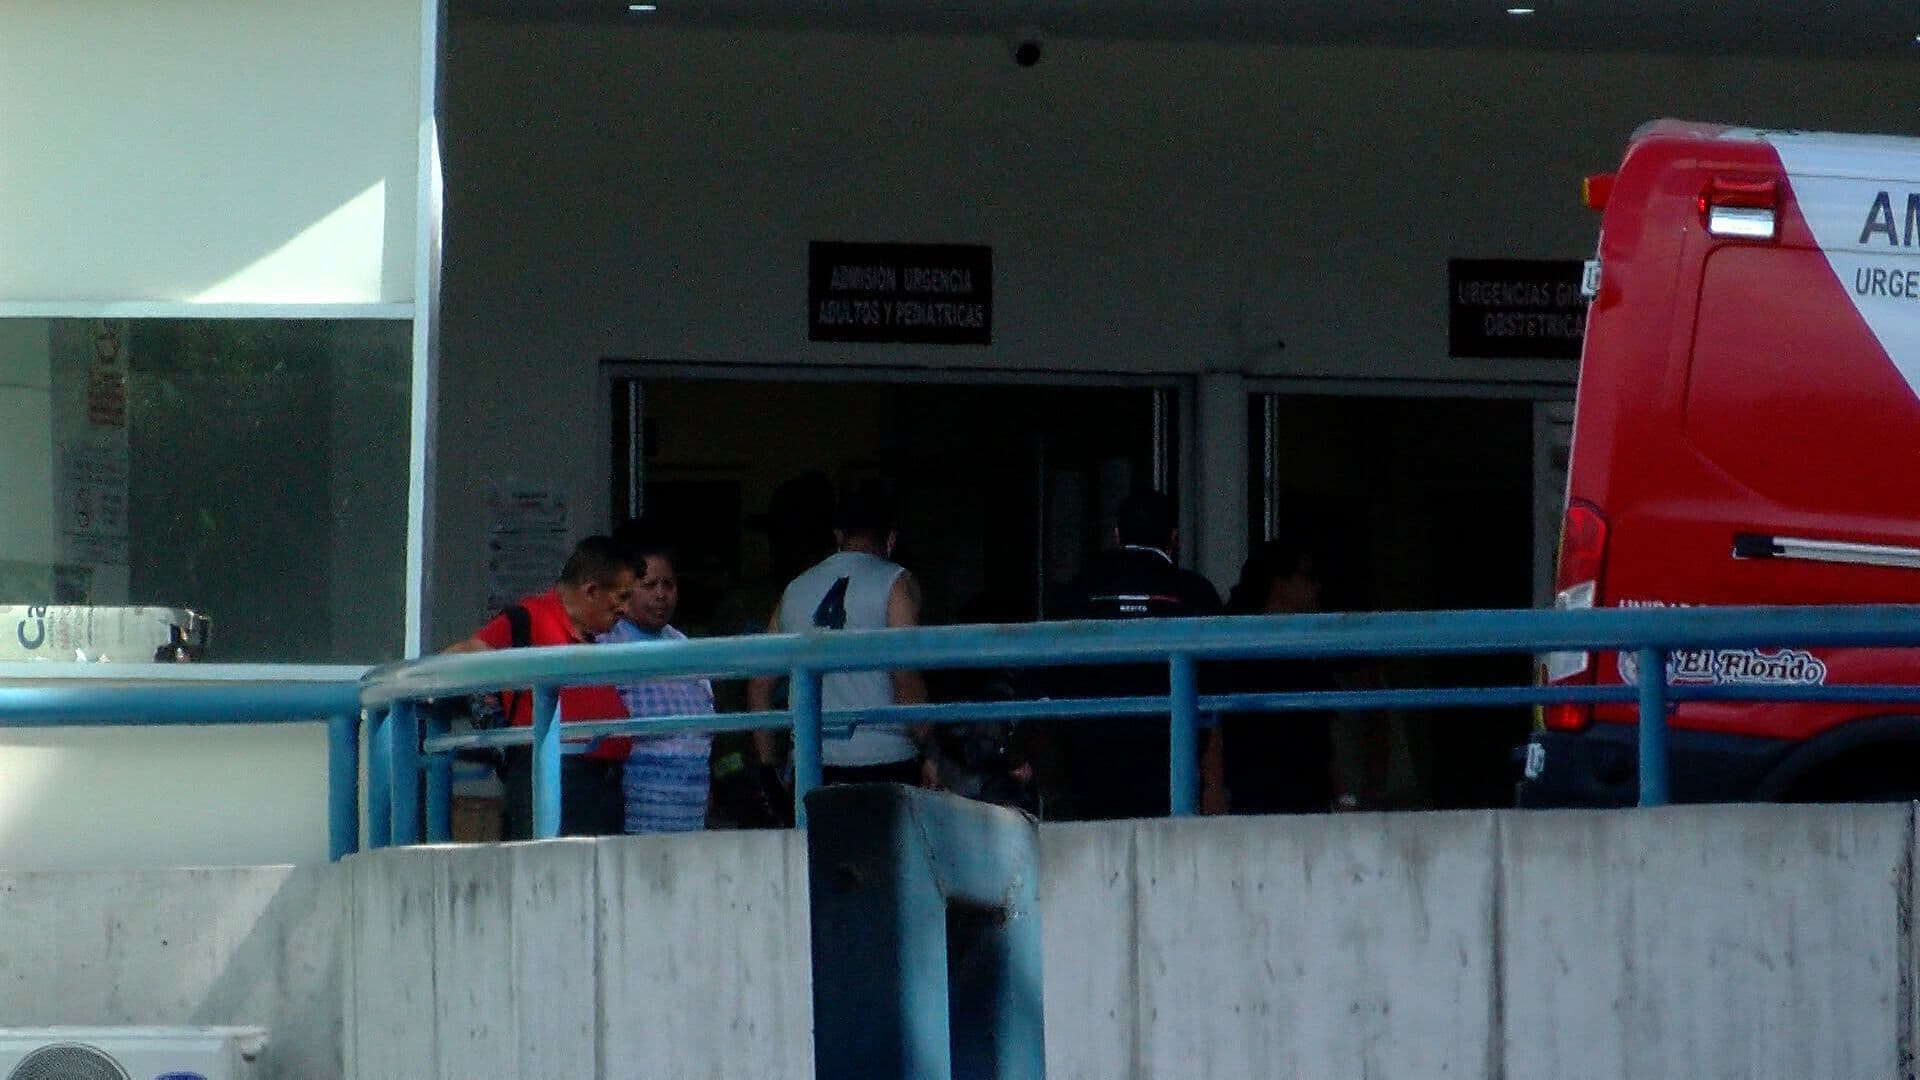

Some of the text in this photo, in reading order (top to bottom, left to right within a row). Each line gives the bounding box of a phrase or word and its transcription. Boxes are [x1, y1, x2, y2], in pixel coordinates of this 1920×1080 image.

[1457, 281, 1551, 306] URGENCIAS
[1856, 267, 1920, 297] URGE
[818, 300, 881, 326] ADULTOS
[883, 301, 894, 325] Y
[813, 575, 848, 630] 4
[1681, 650, 1819, 680] El Florido
